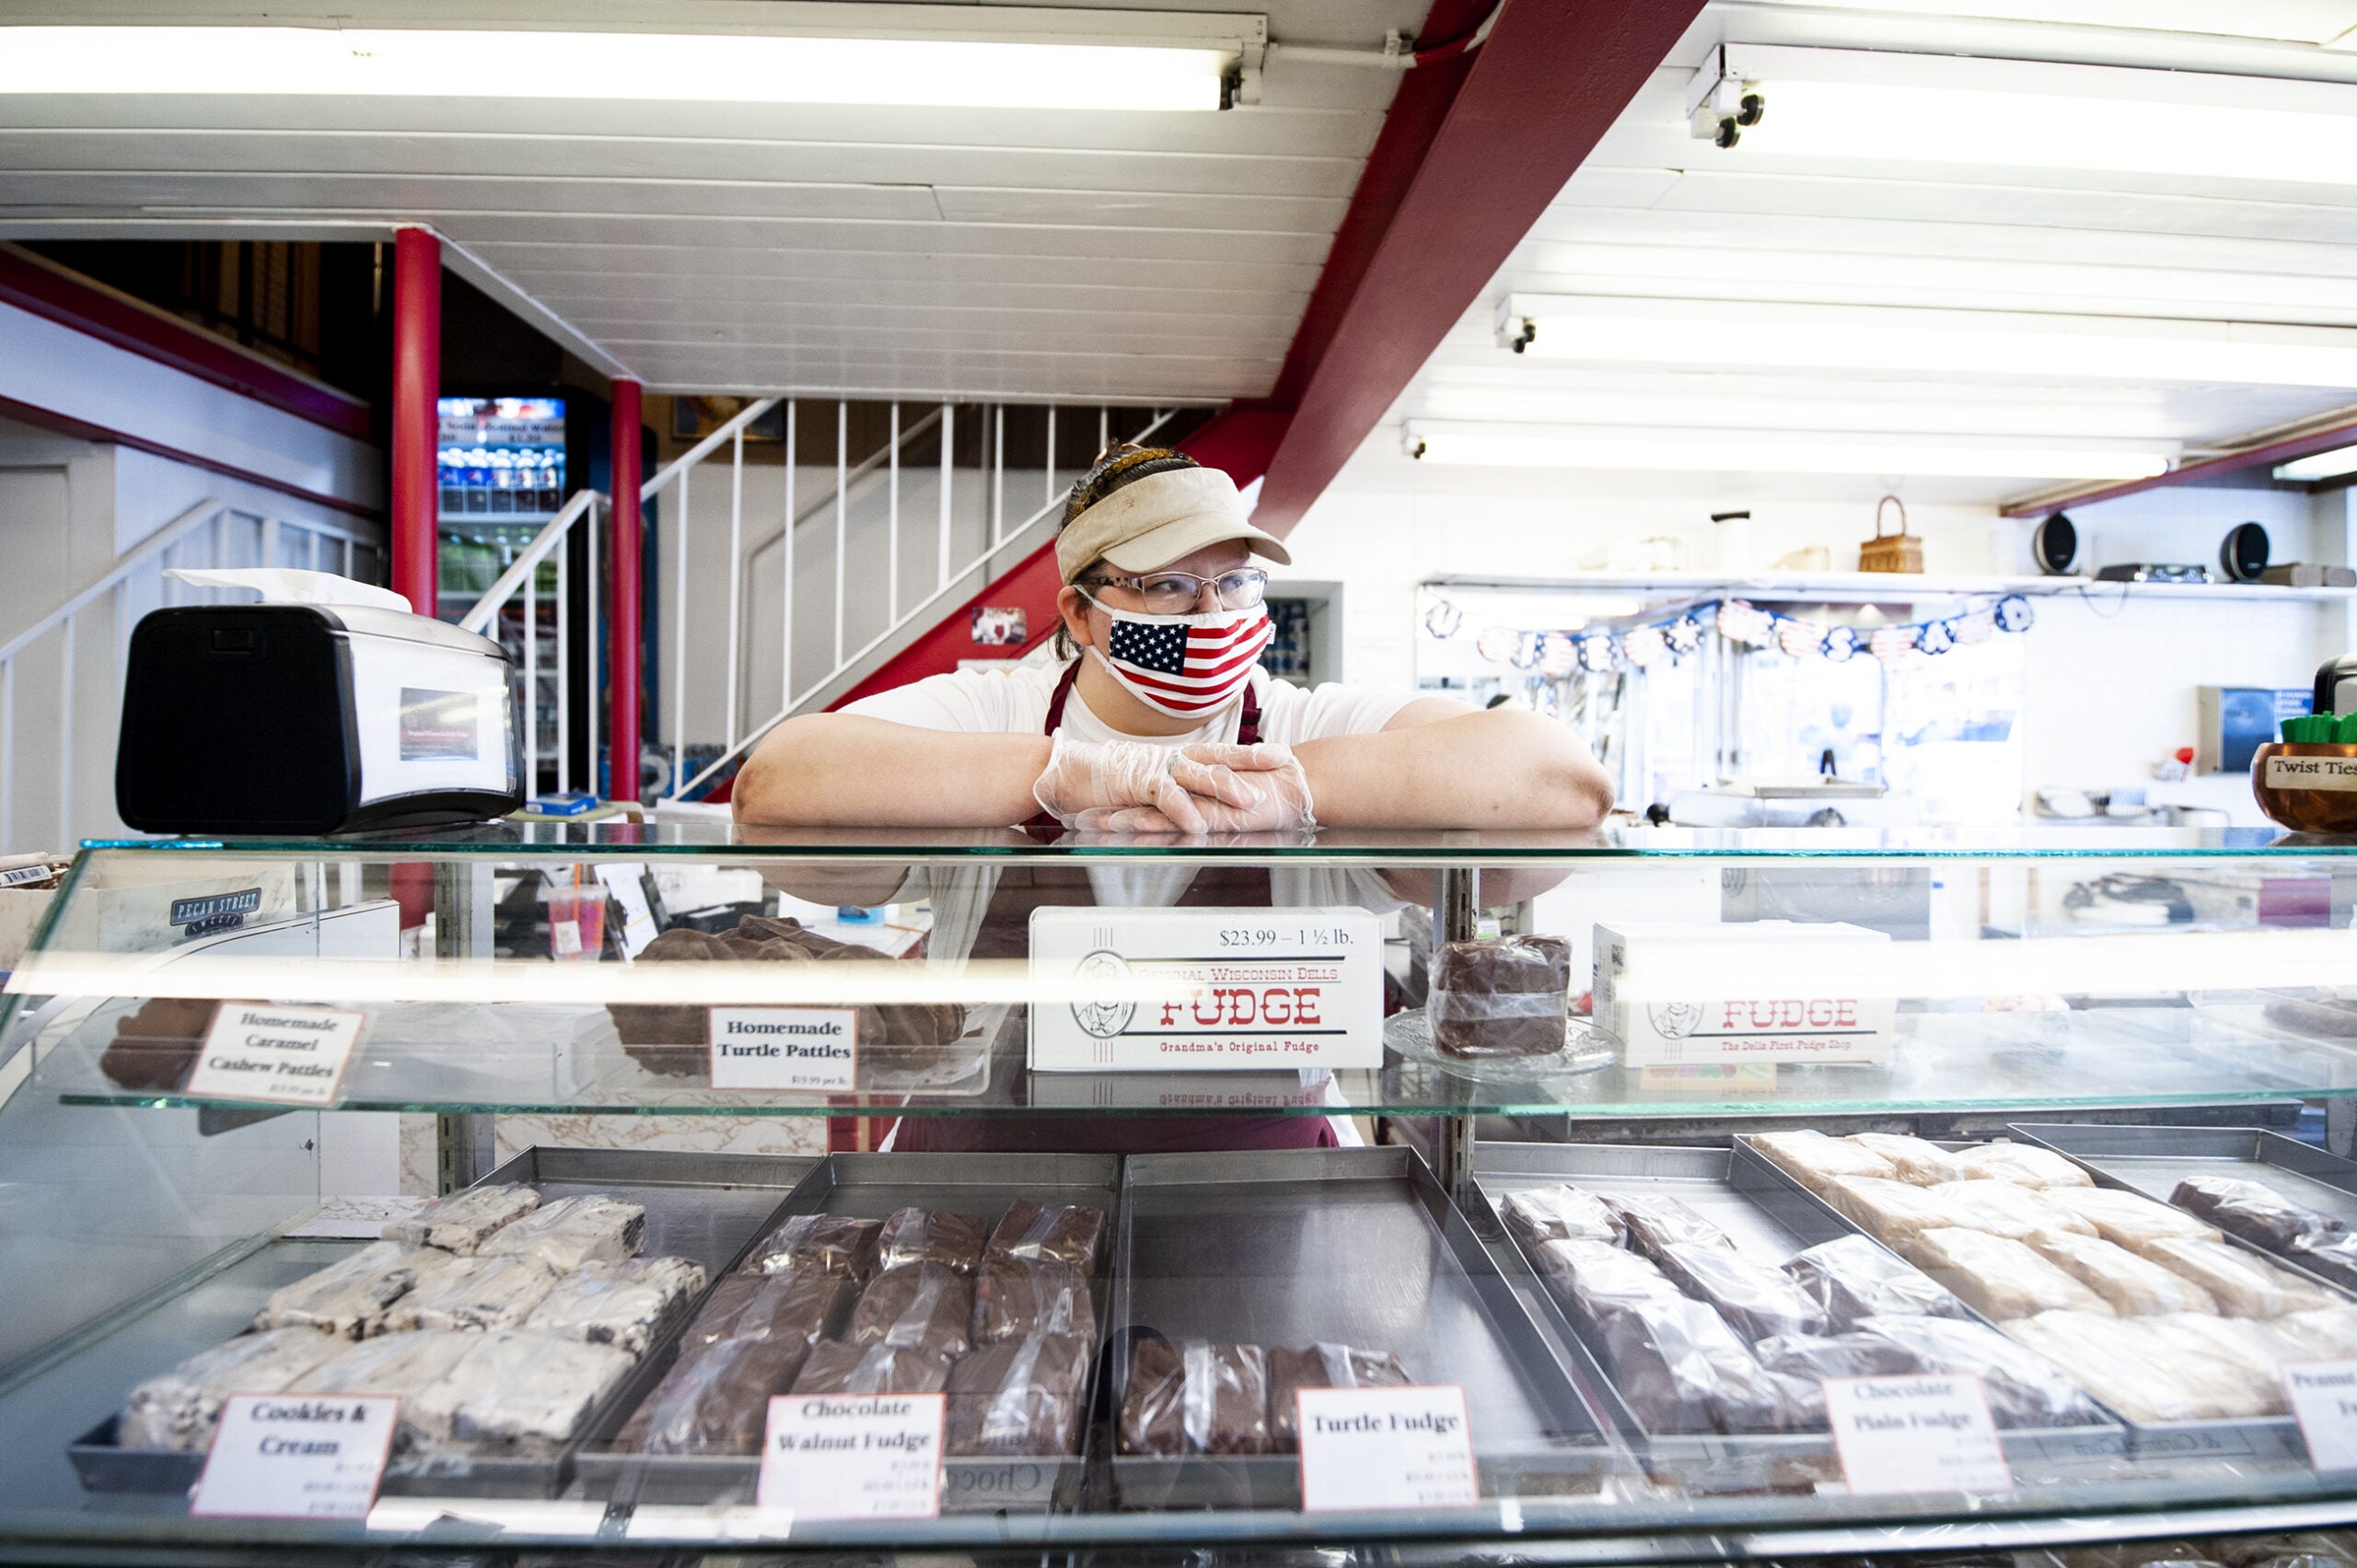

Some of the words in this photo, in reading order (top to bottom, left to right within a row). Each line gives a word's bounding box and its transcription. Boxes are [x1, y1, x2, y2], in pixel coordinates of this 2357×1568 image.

[2274, 760, 2319, 773] Twist
[178, 900, 215, 919] PECAN
[219, 893, 257, 912] STREET
[1219, 929, 1276, 947] $23.99
[1299, 930, 1305, 945] 1
[1334, 928, 1353, 945] lb.
[1211, 968, 1292, 981] WISCONSIN
[1297, 967, 1338, 980] DELLS
[1160, 988, 1320, 1026] FUDGE
[1723, 998, 1857, 1028] FUDGE
[239, 1013, 338, 1031] Homemade
[726, 1021, 842, 1035] Homemade
[245, 1034, 319, 1051] Caramel
[717, 1043, 780, 1058] Turtle
[785, 1044, 852, 1059] Patties
[1160, 1041, 1223, 1052] Grandma's
[1229, 1040, 1278, 1054] Original
[1283, 1041, 1319, 1054] Fudge
[1722, 1041, 1739, 1051] The
[1797, 1040, 1826, 1052] Fudge
[1829, 1039, 1852, 1051] Shop
[208, 1056, 273, 1073] Cashew
[251, 1401, 344, 1422] Cookies
[802, 1400, 911, 1419] Chocolate
[1311, 1412, 1381, 1433] Turtle
[1388, 1411, 1459, 1433] Fudge
[259, 1434, 340, 1454] Cream
[778, 1433, 856, 1451] Walnut
[864, 1430, 931, 1451] Fudge
